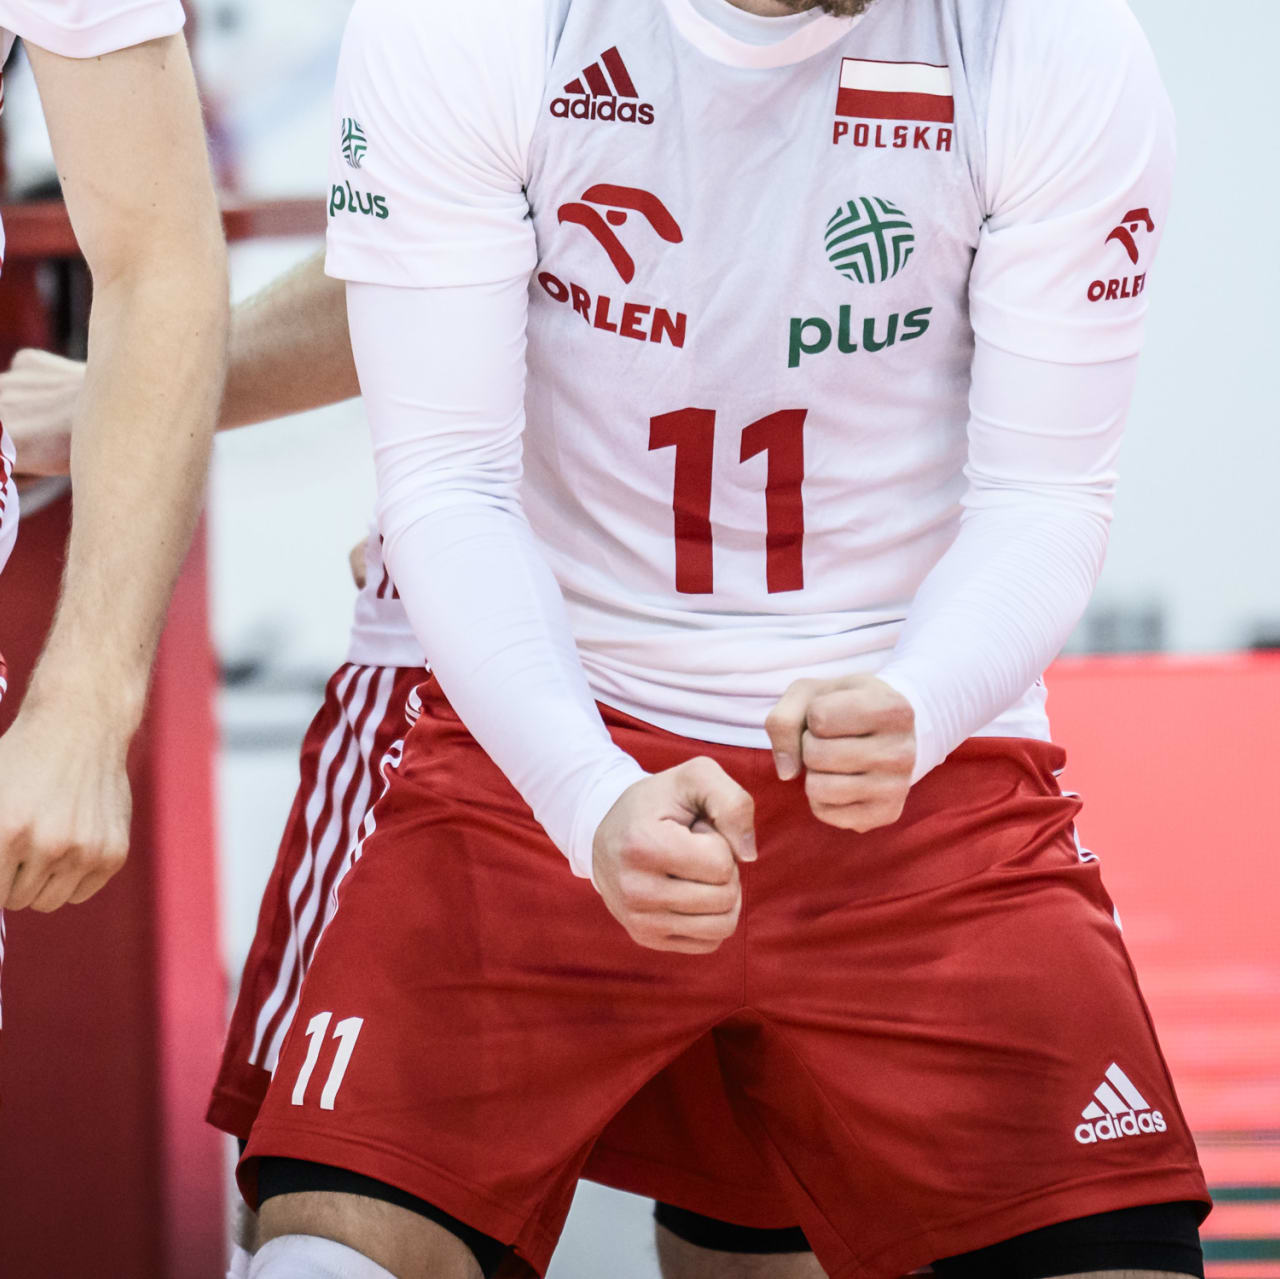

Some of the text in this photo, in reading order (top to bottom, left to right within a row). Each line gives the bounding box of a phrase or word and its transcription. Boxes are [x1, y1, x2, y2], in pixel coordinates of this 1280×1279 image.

[549, 94, 655, 125] adidas
[832, 121, 953, 153] POLSKA
[329, 180, 389, 220] plus
[538, 271, 688, 349] ORLEN
[787, 305, 932, 369] plus
[648, 406, 810, 595] 11
[291, 1011, 364, 1111] 11
[1074, 1108, 1167, 1144] adidas
